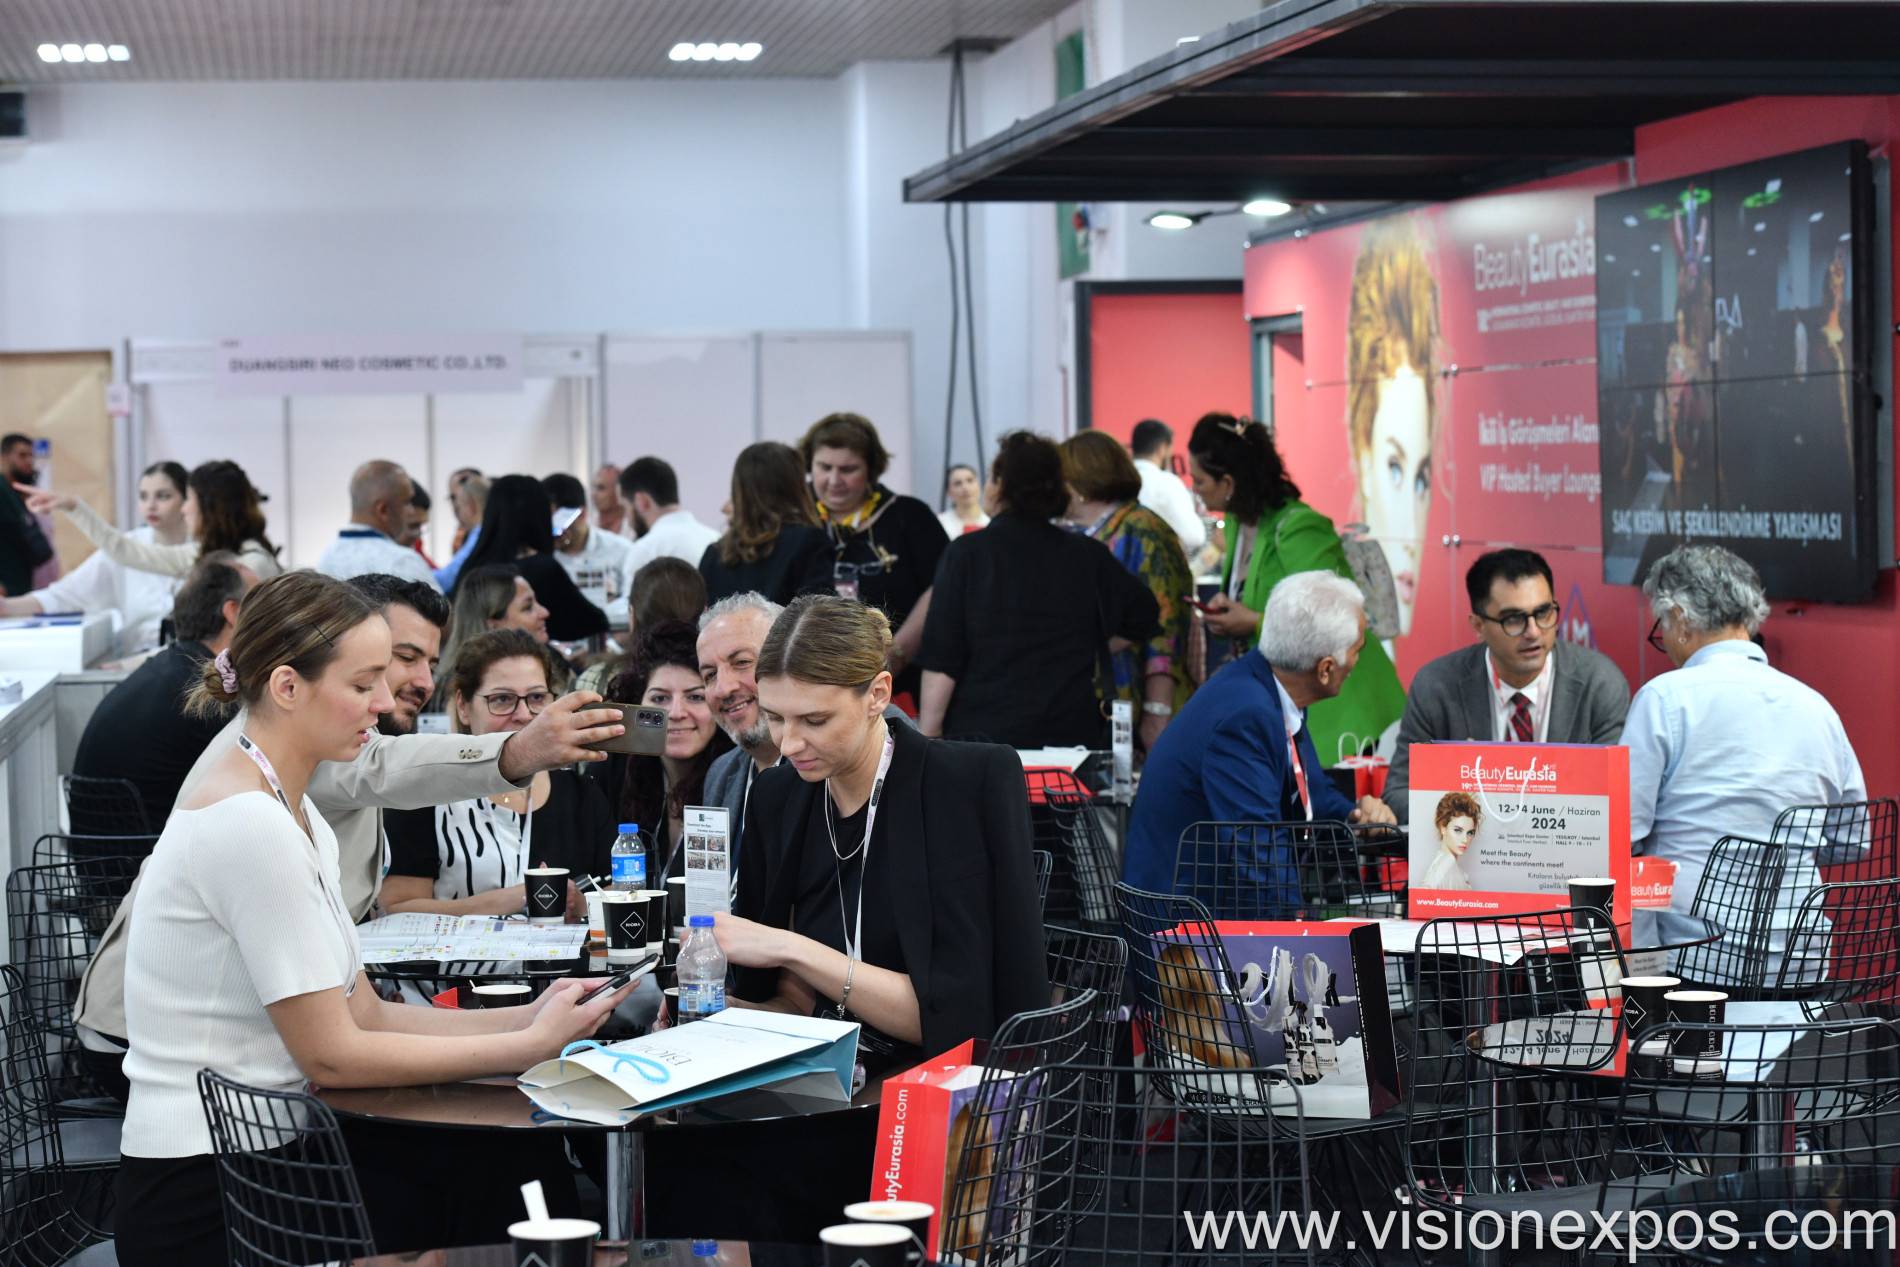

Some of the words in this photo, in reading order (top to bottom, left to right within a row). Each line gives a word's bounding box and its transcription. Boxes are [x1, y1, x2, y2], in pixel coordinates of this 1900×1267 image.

[320, 356, 355, 371] NEO
[359, 355, 440, 371] COSMETIC
[1479, 462, 1496, 492] VIP
[1497, 460, 1532, 494] Hosted
[1533, 462, 1562, 501] Buyer
[1667, 509, 1682, 536] VE
[1531, 804, 1556, 815] June
[1567, 806, 1601, 816] Haziran
[1531, 817, 1567, 830] 2024
[1497, 849, 1508, 857] the
[1509, 850, 1532, 859] Beauty
[1513, 860, 1545, 868] continents
[1416, 897, 1499, 909] www.BeautyEurasia.com
